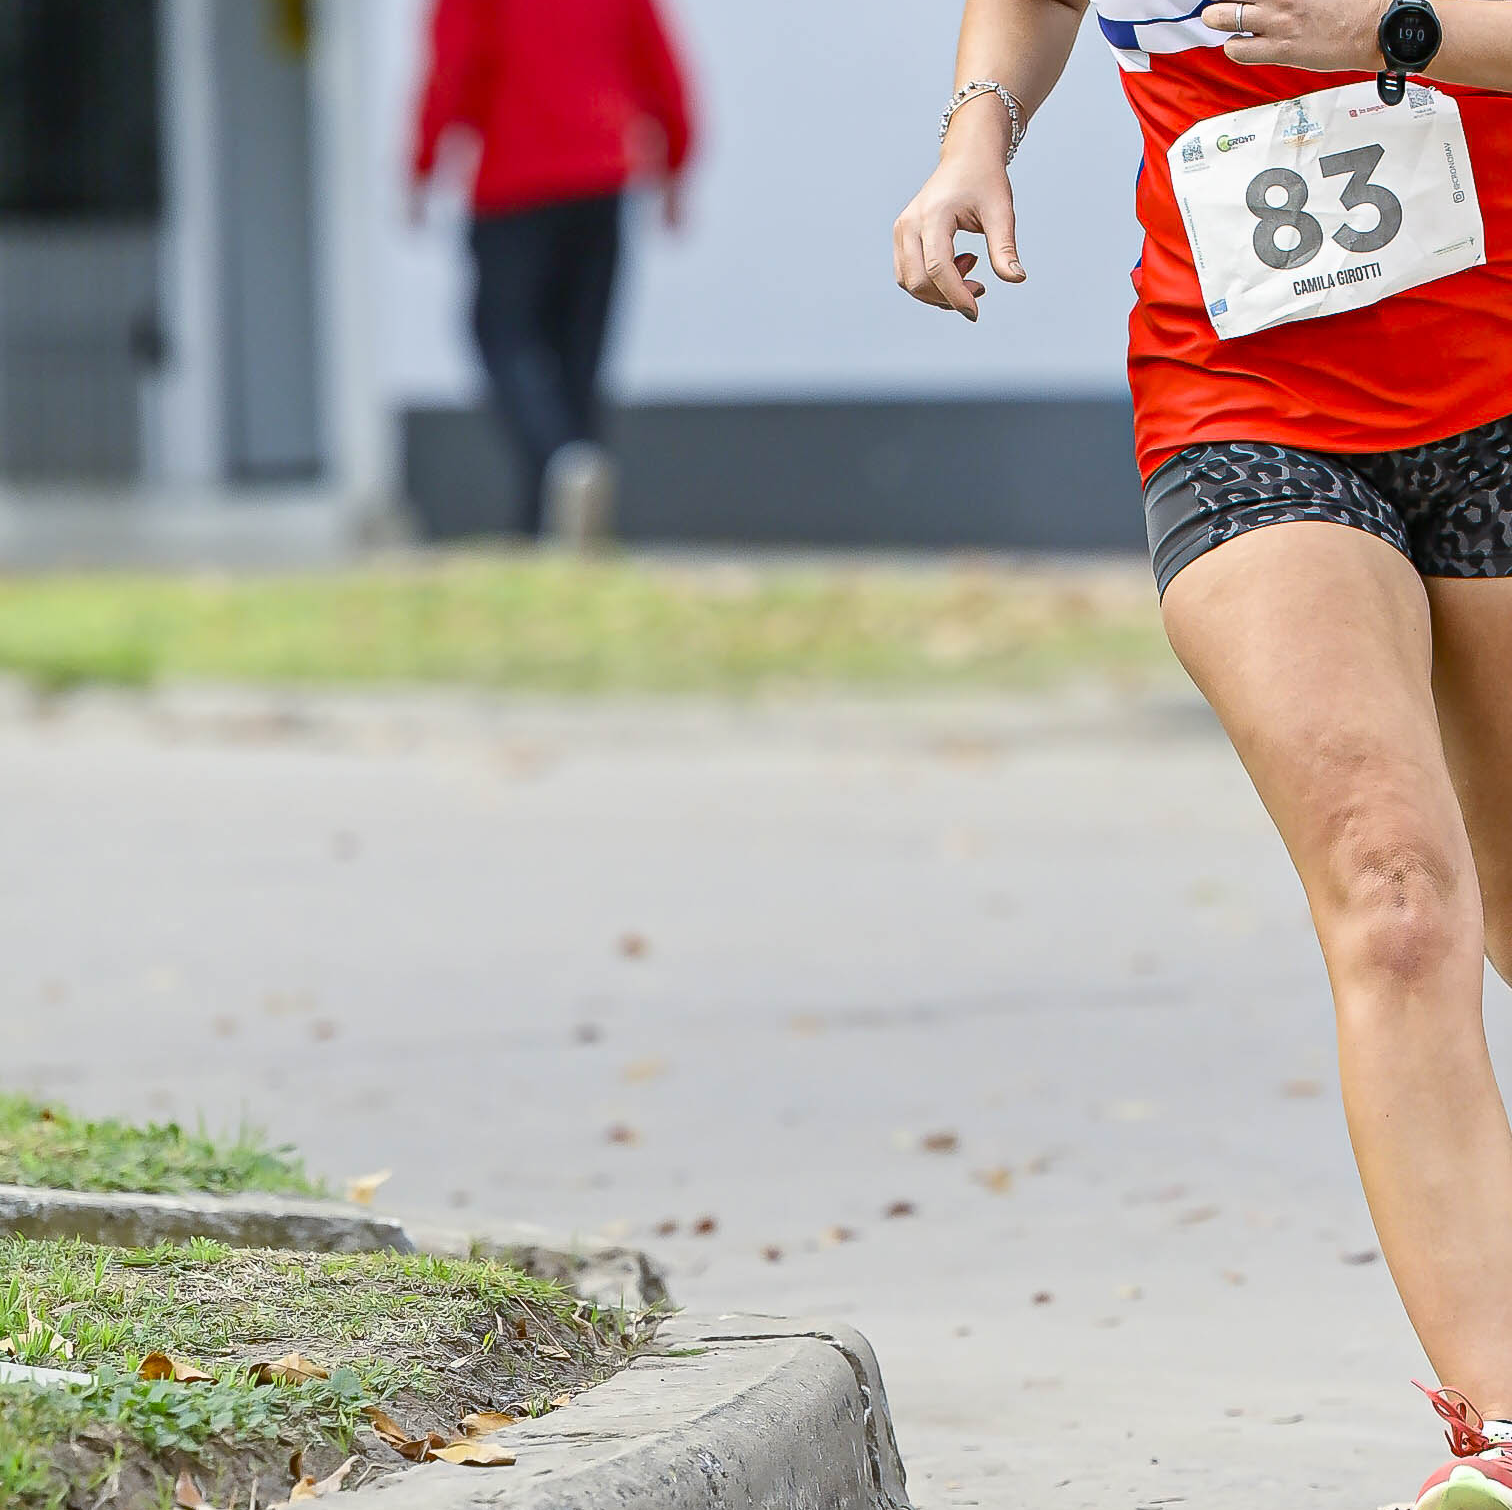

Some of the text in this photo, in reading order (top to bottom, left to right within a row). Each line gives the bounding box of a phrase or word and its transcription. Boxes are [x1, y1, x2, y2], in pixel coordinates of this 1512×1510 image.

[1246, 144, 1403, 270] 83
[1293, 262, 1382, 295] CAMILA GIROTTI
